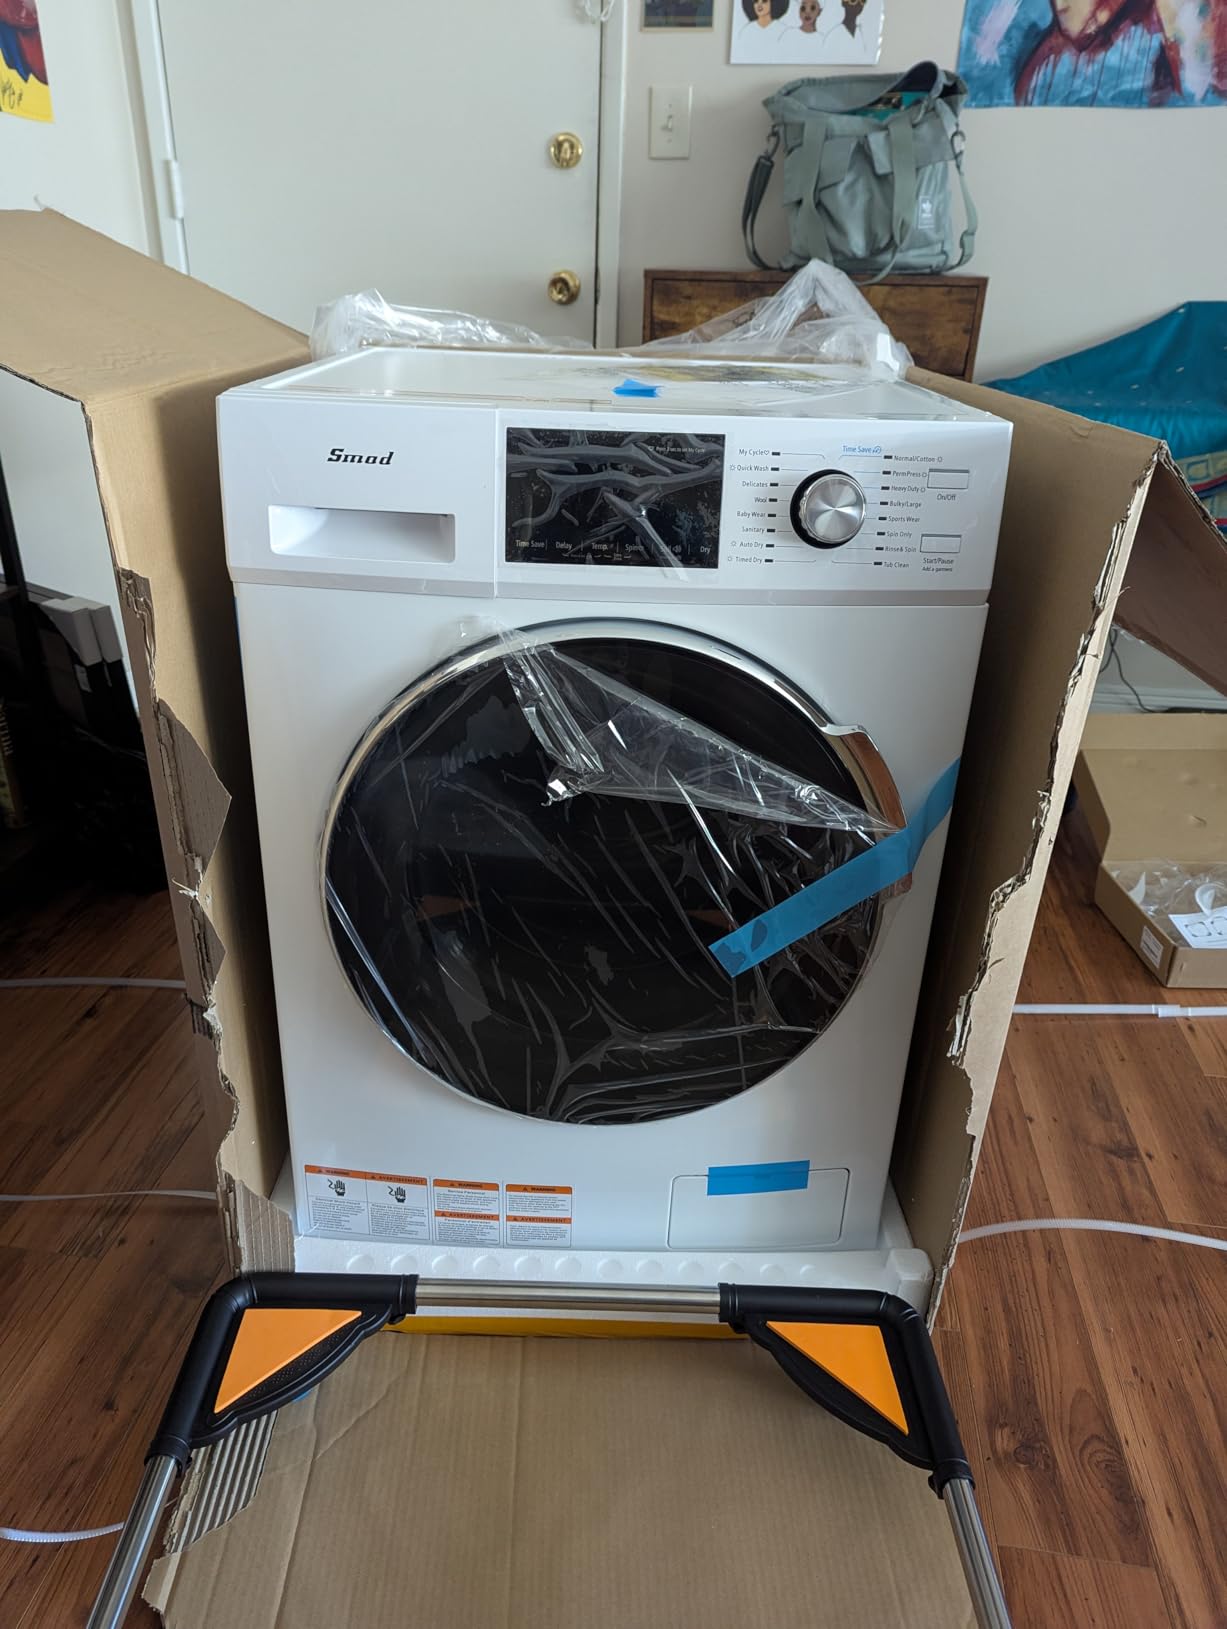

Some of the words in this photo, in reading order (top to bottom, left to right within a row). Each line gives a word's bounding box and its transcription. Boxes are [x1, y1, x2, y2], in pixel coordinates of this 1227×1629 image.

[327, 448, 394, 465] Smad
[937, 493, 956, 501] On/Off
[530, 540, 545, 548] Save
[555, 541, 572, 551] Delay
[700, 545, 710, 555] Dry
[922, 557, 954, 565] Start/Pause
